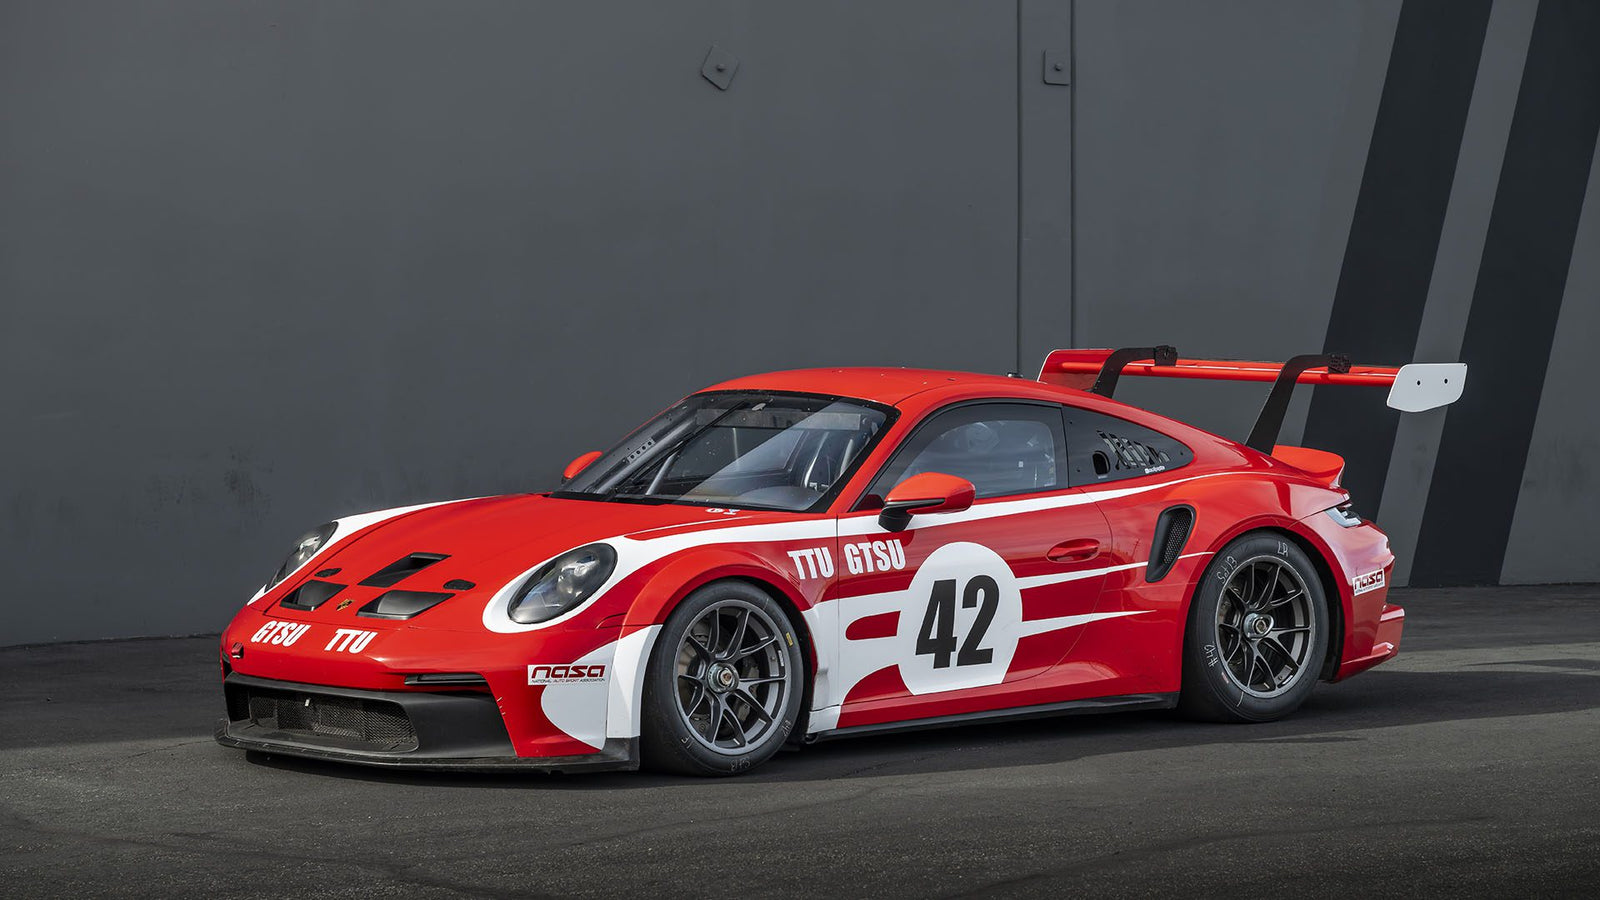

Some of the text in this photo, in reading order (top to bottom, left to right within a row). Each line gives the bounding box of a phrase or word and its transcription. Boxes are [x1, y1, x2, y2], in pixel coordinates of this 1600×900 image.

[787, 539, 906, 580] TTU GTSU
[250, 620, 378, 654] GTSU TTU
[915, 574, 1000, 669] 42
